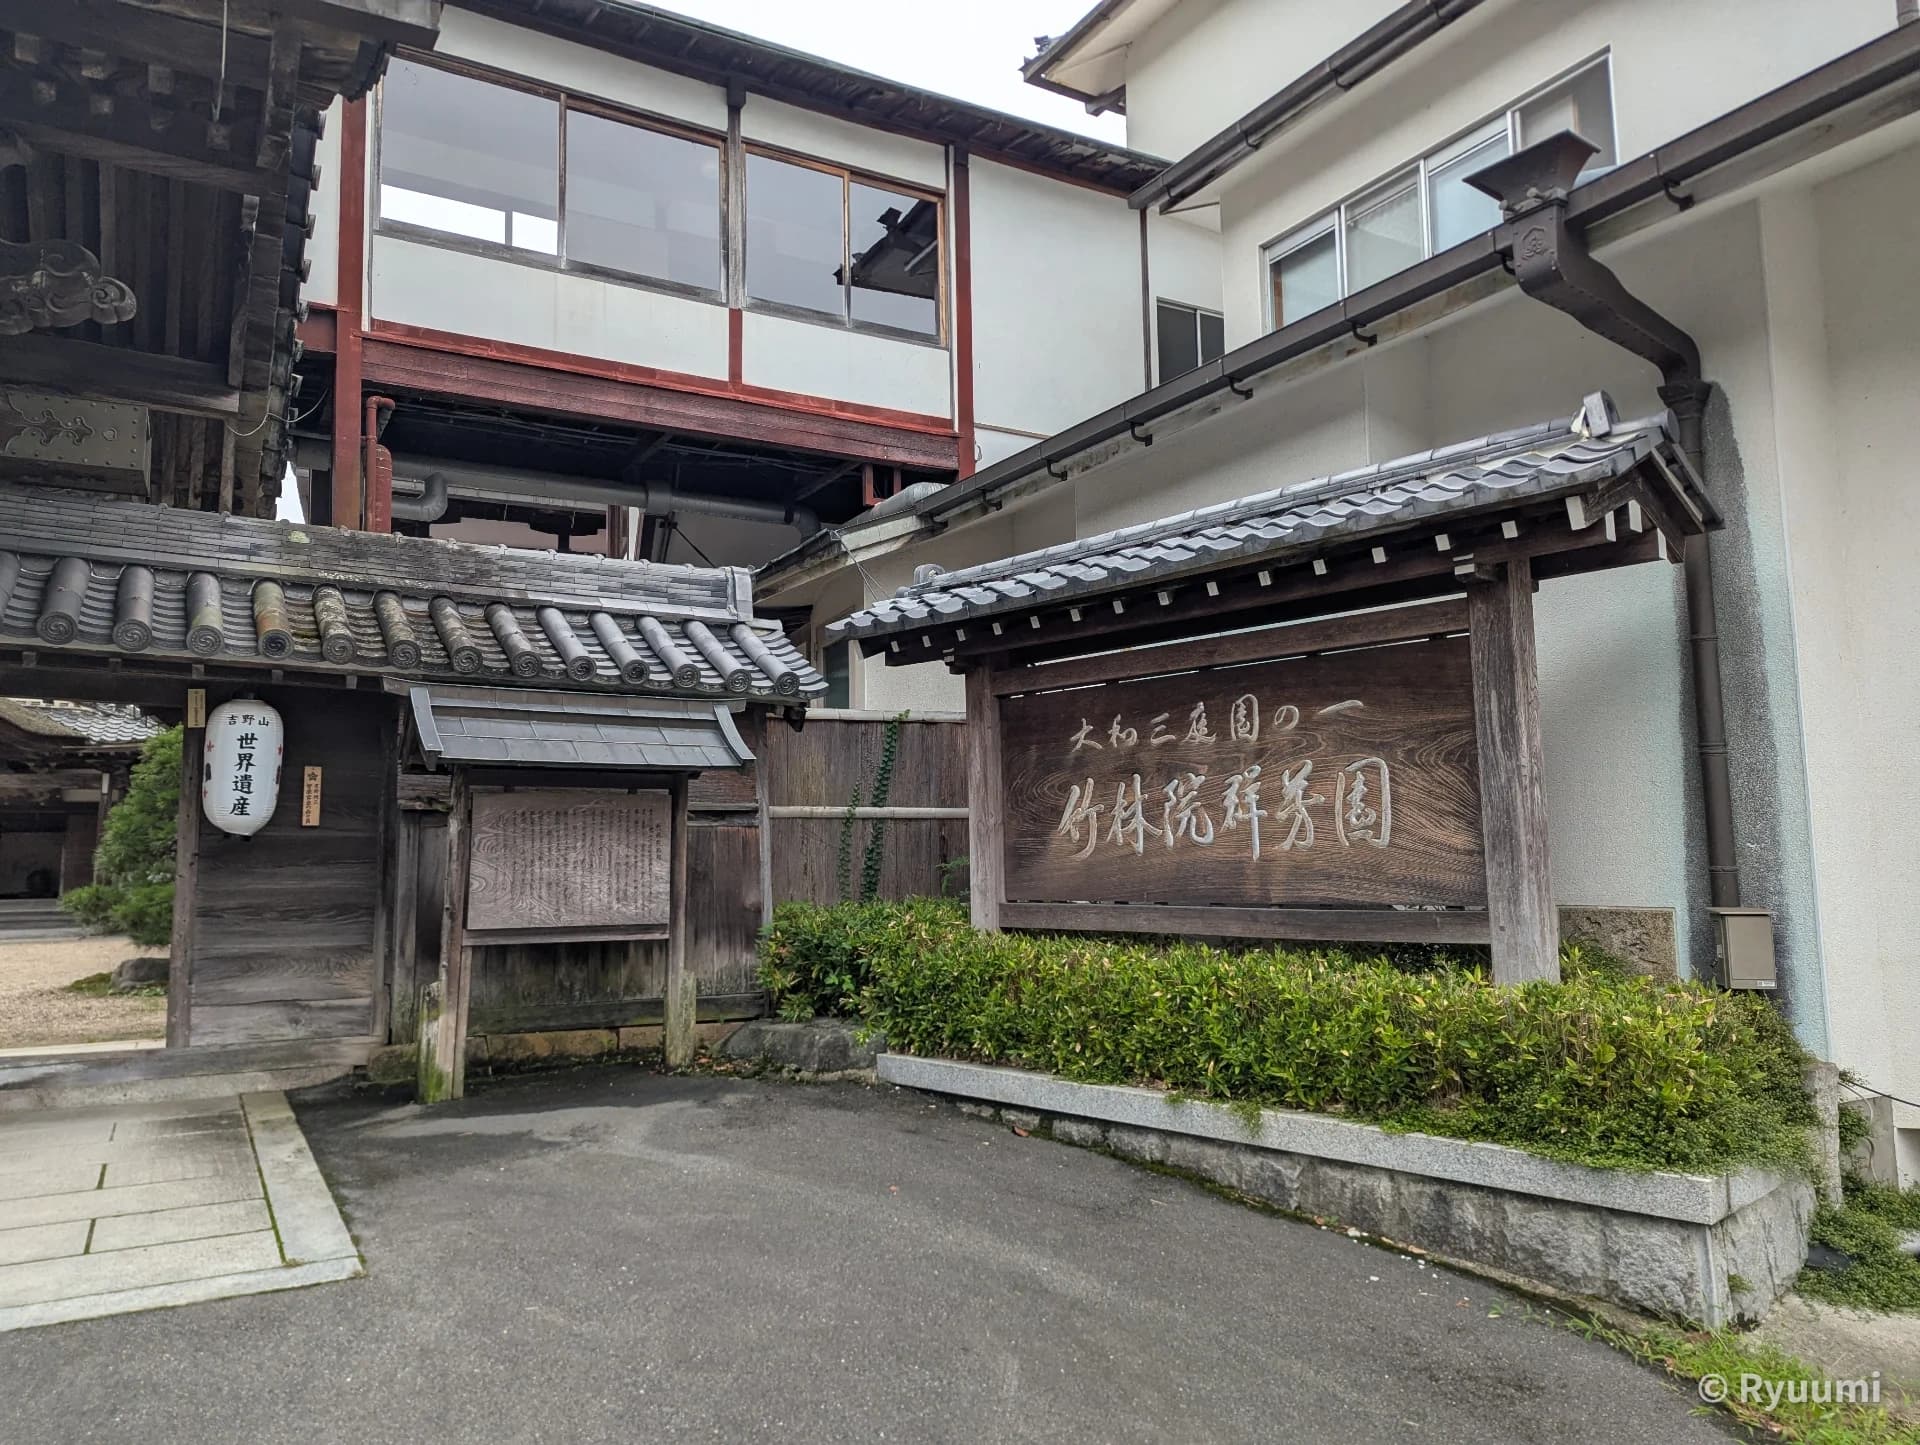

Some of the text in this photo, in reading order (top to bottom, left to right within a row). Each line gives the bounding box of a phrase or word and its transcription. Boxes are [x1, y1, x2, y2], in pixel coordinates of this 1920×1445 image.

[227, 714, 270, 727] 吉野山
[229, 732, 259, 816] 世界遺産
[1057, 757, 1391, 862] 竹林院群芳園
